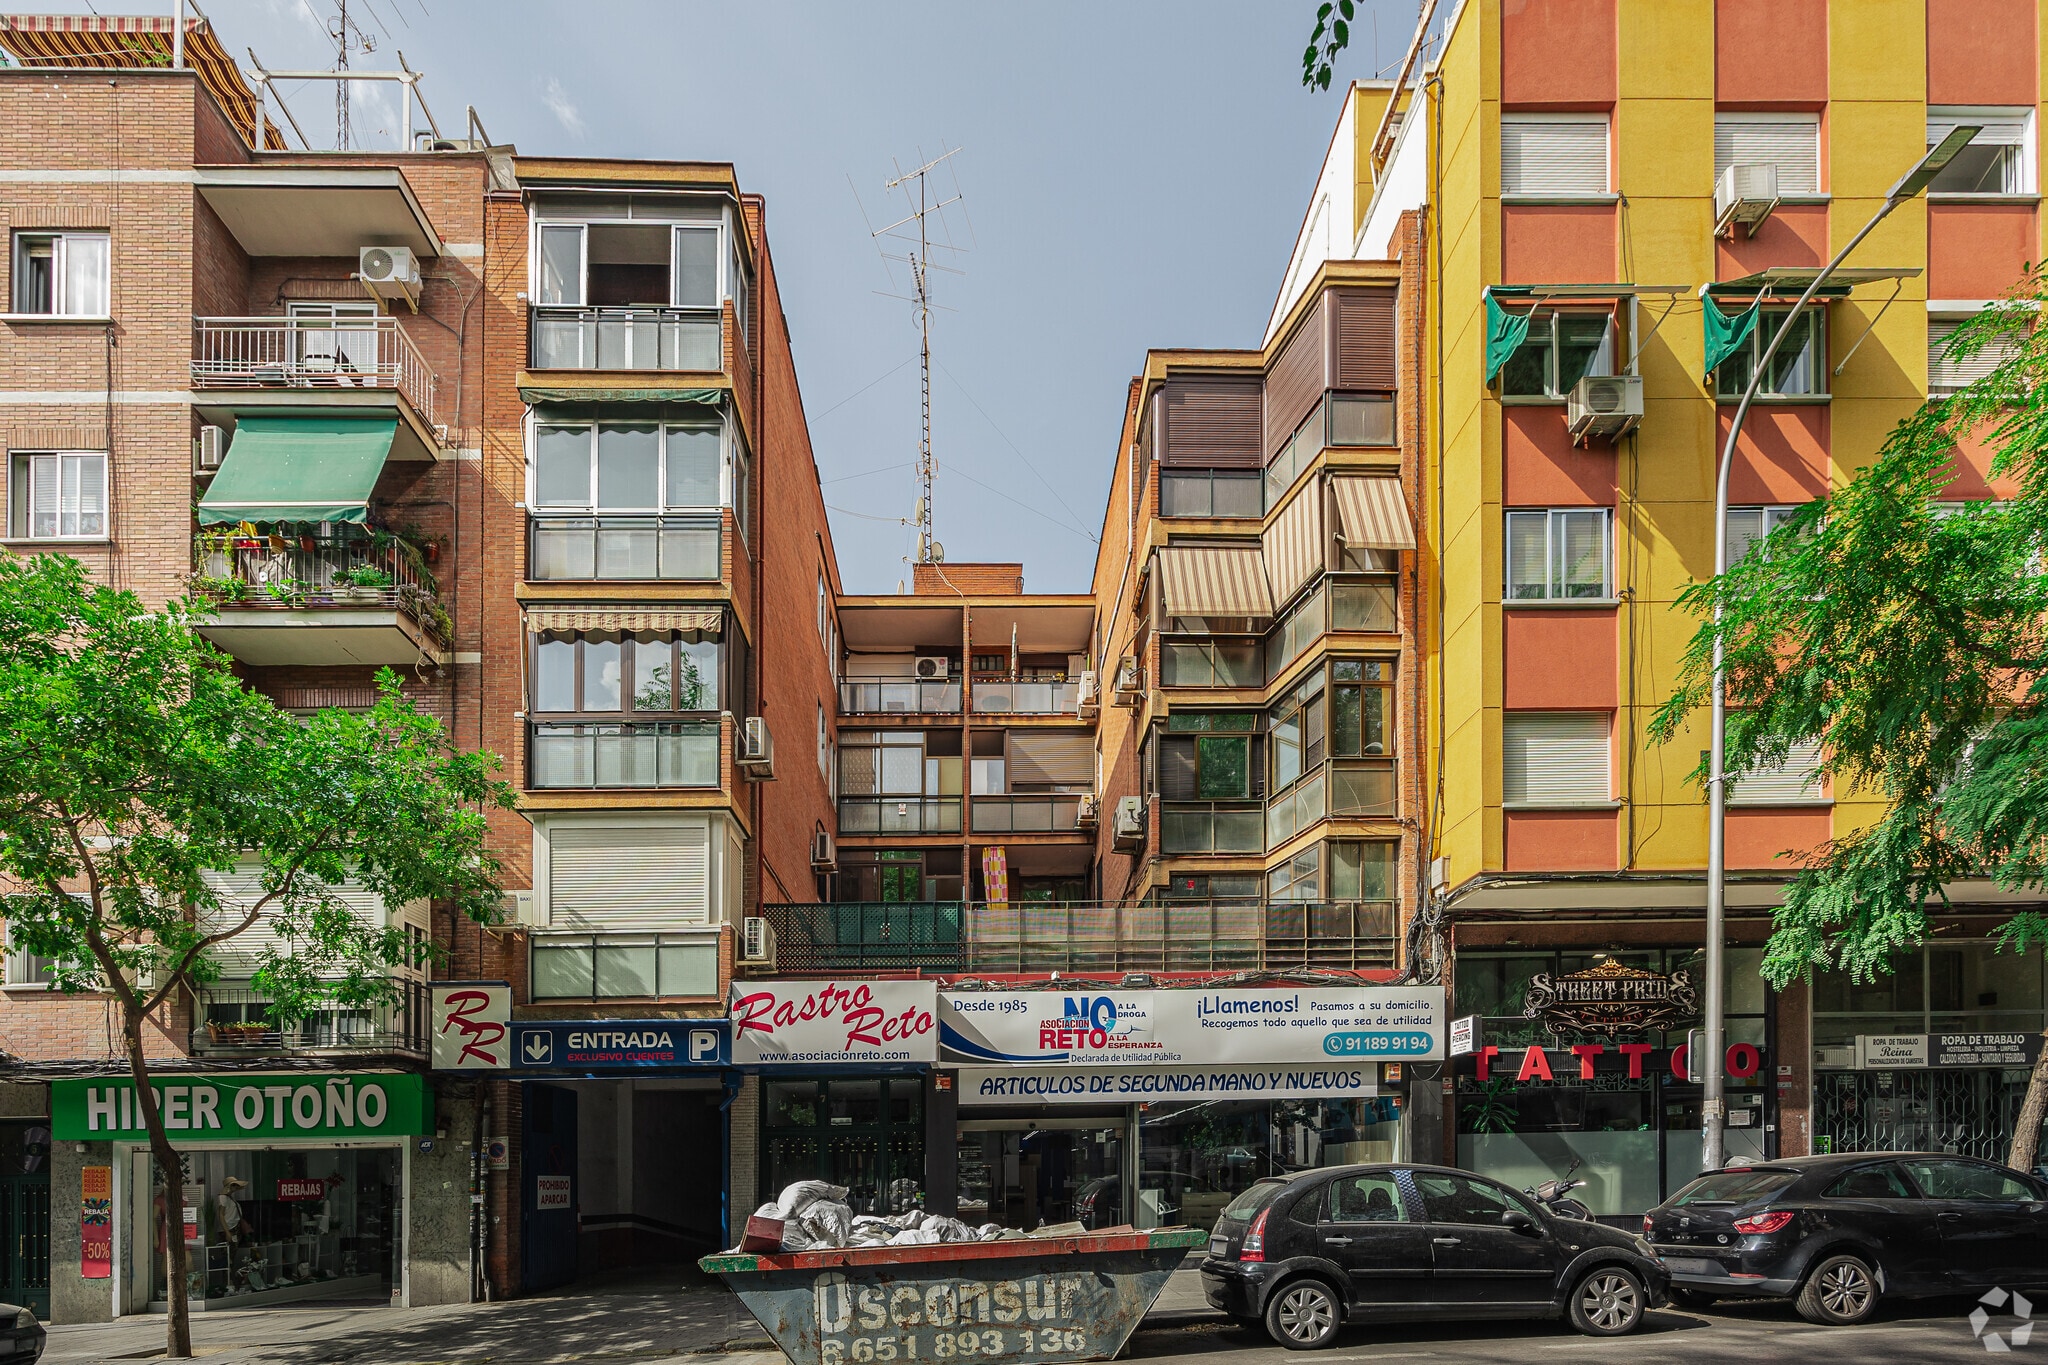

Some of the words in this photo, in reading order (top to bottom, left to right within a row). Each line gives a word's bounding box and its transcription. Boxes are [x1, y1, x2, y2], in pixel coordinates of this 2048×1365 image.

[733, 983, 874, 1040] Rastro
[953, 1000, 995, 1012] Desde
[999, 1001, 1028, 1013] 1985
[1197, 994, 1299, 1018] ¡Llamenos!
[1310, 1001, 1355, 1011] Pasamos
[1385, 1000, 1433, 1010] domicilio.
[1064, 996, 1117, 1033] NO
[842, 1005, 935, 1051] Reto
[1040, 1019, 1089, 1029] ASOCIACION
[1201, 1019, 1258, 1030] Recogemos
[1263, 1017, 1287, 1028] todo
[1291, 1016, 1327, 1028] aquello
[1331, 1018, 1350, 1028] que
[1354, 1018, 1372, 1026] sea
[1376, 1016, 1389, 1025] de
[1393, 1015, 1432, 1025] utilidad
[1454, 1020, 1469, 1031] TATTOO
[1039, 1028, 1107, 1049] RETO
[1345, 1037, 1361, 1050] 91
[1364, 1037, 1389, 1050] 189
[1392, 1037, 1407, 1050] 91
[1410, 1036, 1428, 1050] 94
[1452, 1032, 1471, 1044] PIERCING
[1873, 1038, 1886, 1046] ROPA
[1888, 1038, 1896, 1046] DE
[1896, 1038, 1919, 1046] TRABAJO
[1941, 1035, 1967, 1045] ROPA
[1969, 1035, 1981, 1045] DE
[1983, 1034, 2025, 1045] TRABAJO
[567, 1031, 674, 1049] ENTRADA
[691, 1032, 717, 1059] P
[1879, 1046, 1914, 1057] Reina
[567, 1053, 623, 1062] EXCLUSIVO
[626, 1052, 674, 1061] CLIENTES
[758, 1050, 910, 1061] www.asociacionreto.com
[1071, 1054, 1113, 1063] Declarada
[1113, 1054, 1120, 1062] de
[1122, 1053, 1153, 1062] Utilidad
[1154, 1051, 1182, 1062] Pública
[980, 1075, 1085, 1096] ARTICULOS
[1089, 1075, 1115, 1093] DE
[1118, 1073, 1206, 1093] SEGUNDA
[1208, 1072, 1266, 1092] MANO
[1268, 1072, 1282, 1091] Y
[1286, 1070, 1362, 1091] NUEVOS
[87, 1086, 221, 1131] HIPER
[234, 1077, 388, 1130] OTOÑO
[281, 1183, 321, 1196] REBAJAS
[539, 1180, 569, 1190] PROHIBIDO
[541, 1194, 568, 1205] APARCAR
[83, 1242, 110, 1259] -50%
[851, 1334, 917, 1364] 651
[934, 1330, 1005, 1358] 893
[1019, 1327, 1086, 1354] 136
